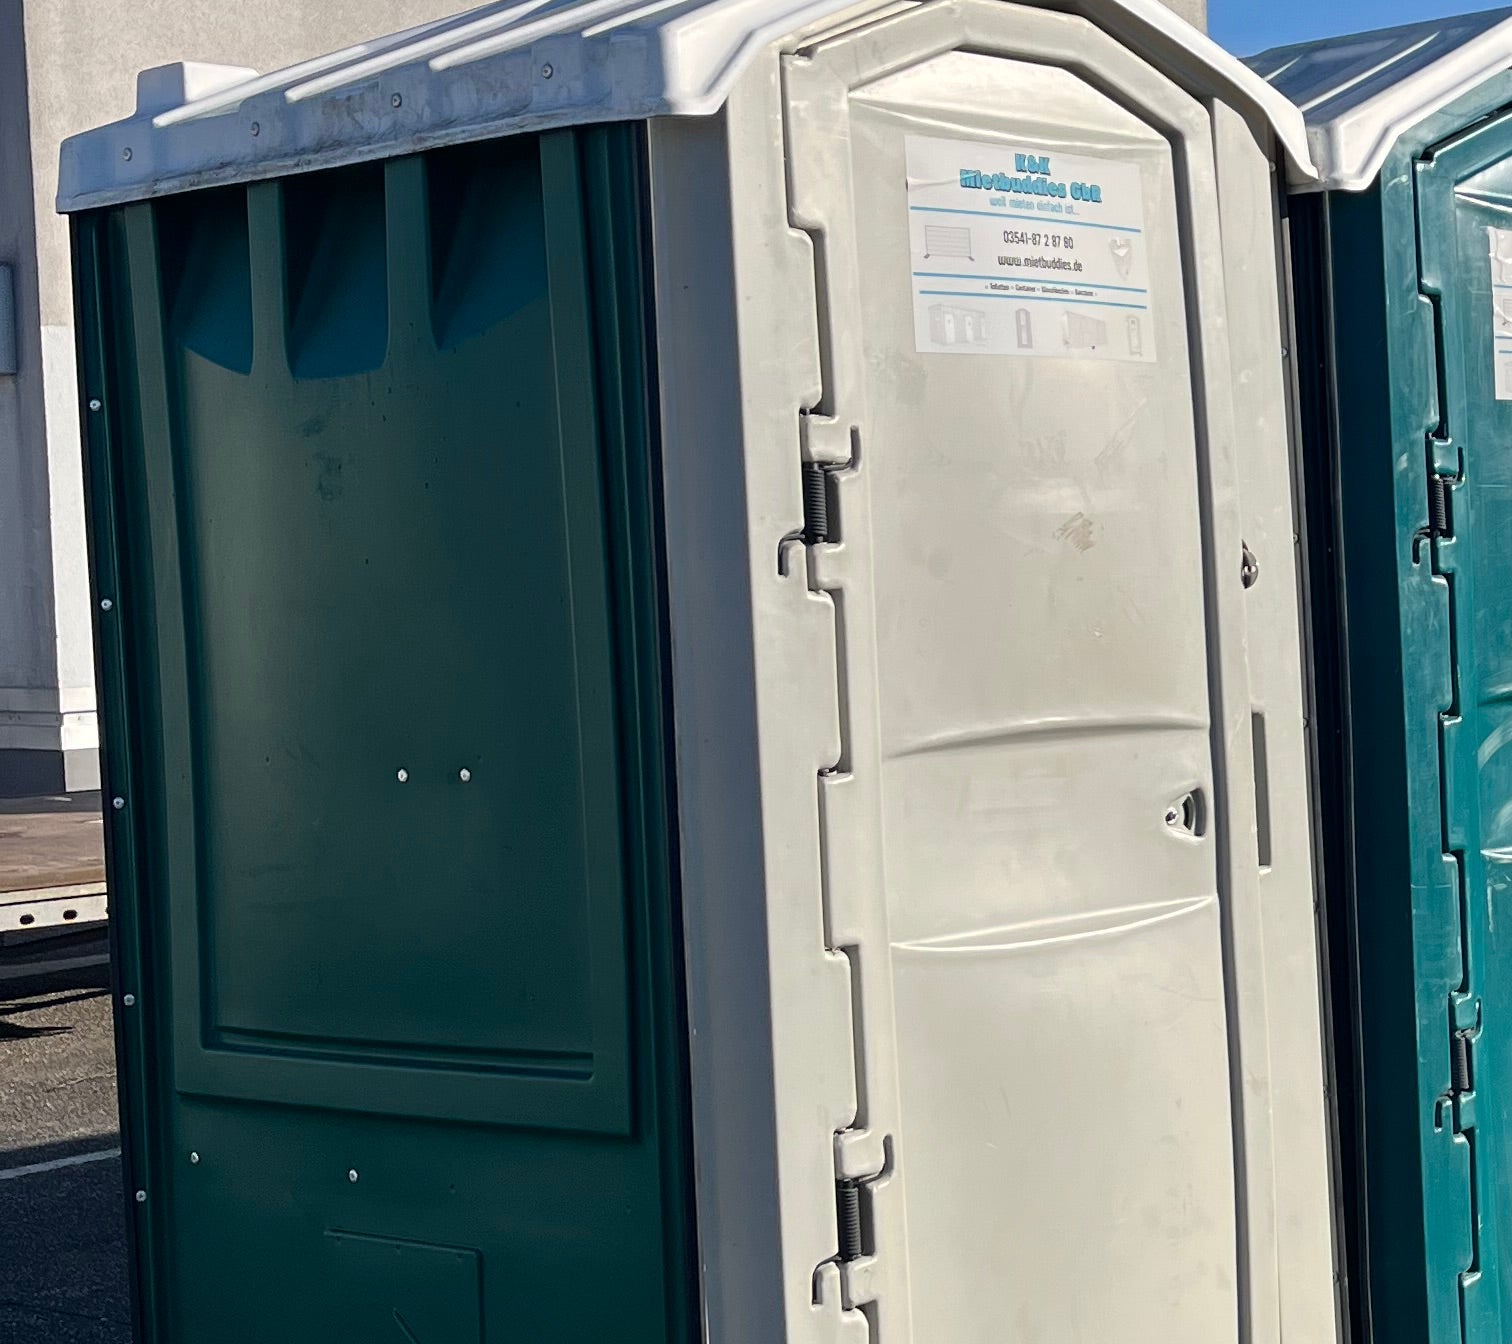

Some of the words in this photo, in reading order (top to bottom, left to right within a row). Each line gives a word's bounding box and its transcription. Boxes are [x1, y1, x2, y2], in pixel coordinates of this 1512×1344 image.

[1015, 153, 1050, 176] K&K
[960, 169, 1066, 198] Mietbuddies
[1070, 182, 1102, 203] GbR
[1003, 230, 1041, 246] 03541-87
[1043, 233, 1050, 247] 2
[1051, 234, 1061, 248] 87
[998, 255, 1083, 272] www.mietbuddies.de
